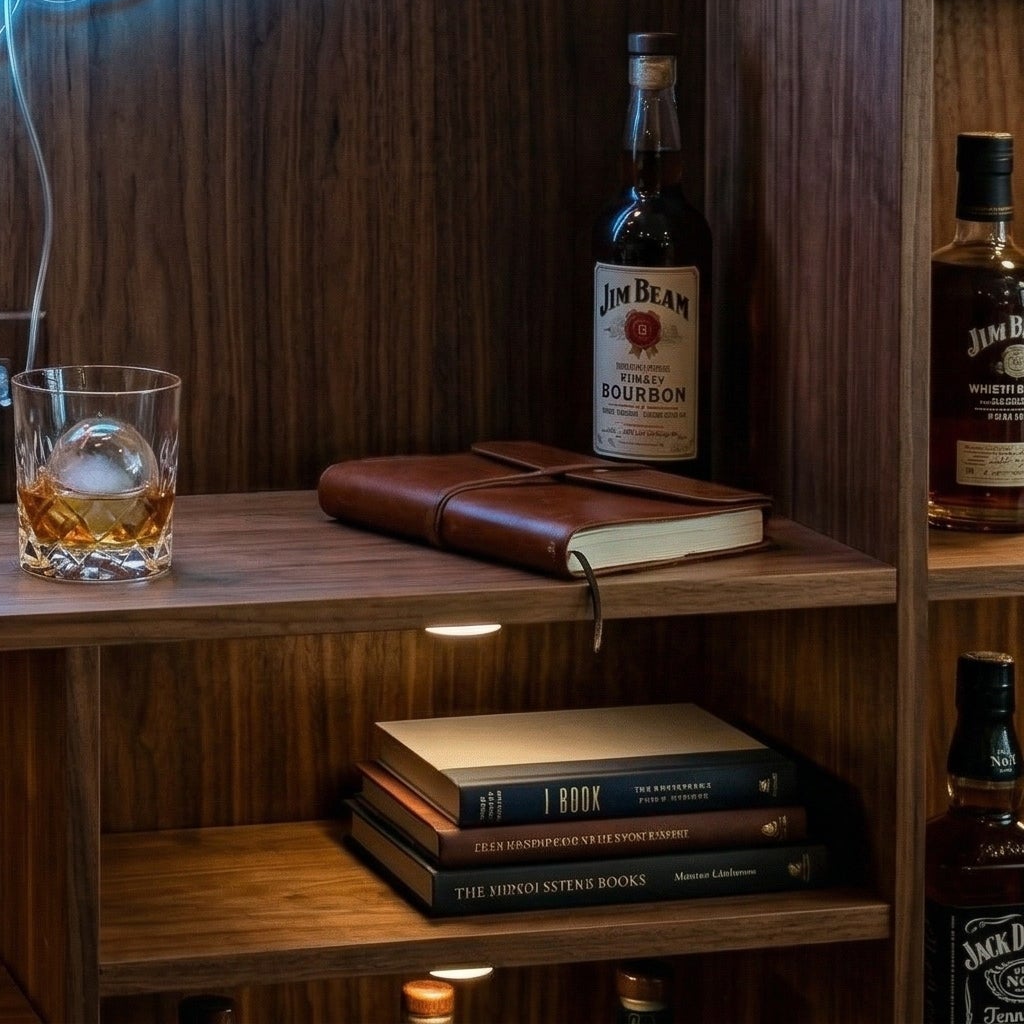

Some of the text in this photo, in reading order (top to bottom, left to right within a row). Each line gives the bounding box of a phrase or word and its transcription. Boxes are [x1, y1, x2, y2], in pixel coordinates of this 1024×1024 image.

[600, 278, 689, 321] JIM BEAM
[968, 314, 1024, 357] JIM B
[602, 383, 686, 403] BOURBON
[559, 785, 602, 814] BOOK
[454, 887, 486, 900] THE
[598, 874, 647, 889] BOOKS
[962, 931, 1012, 971] JACK
